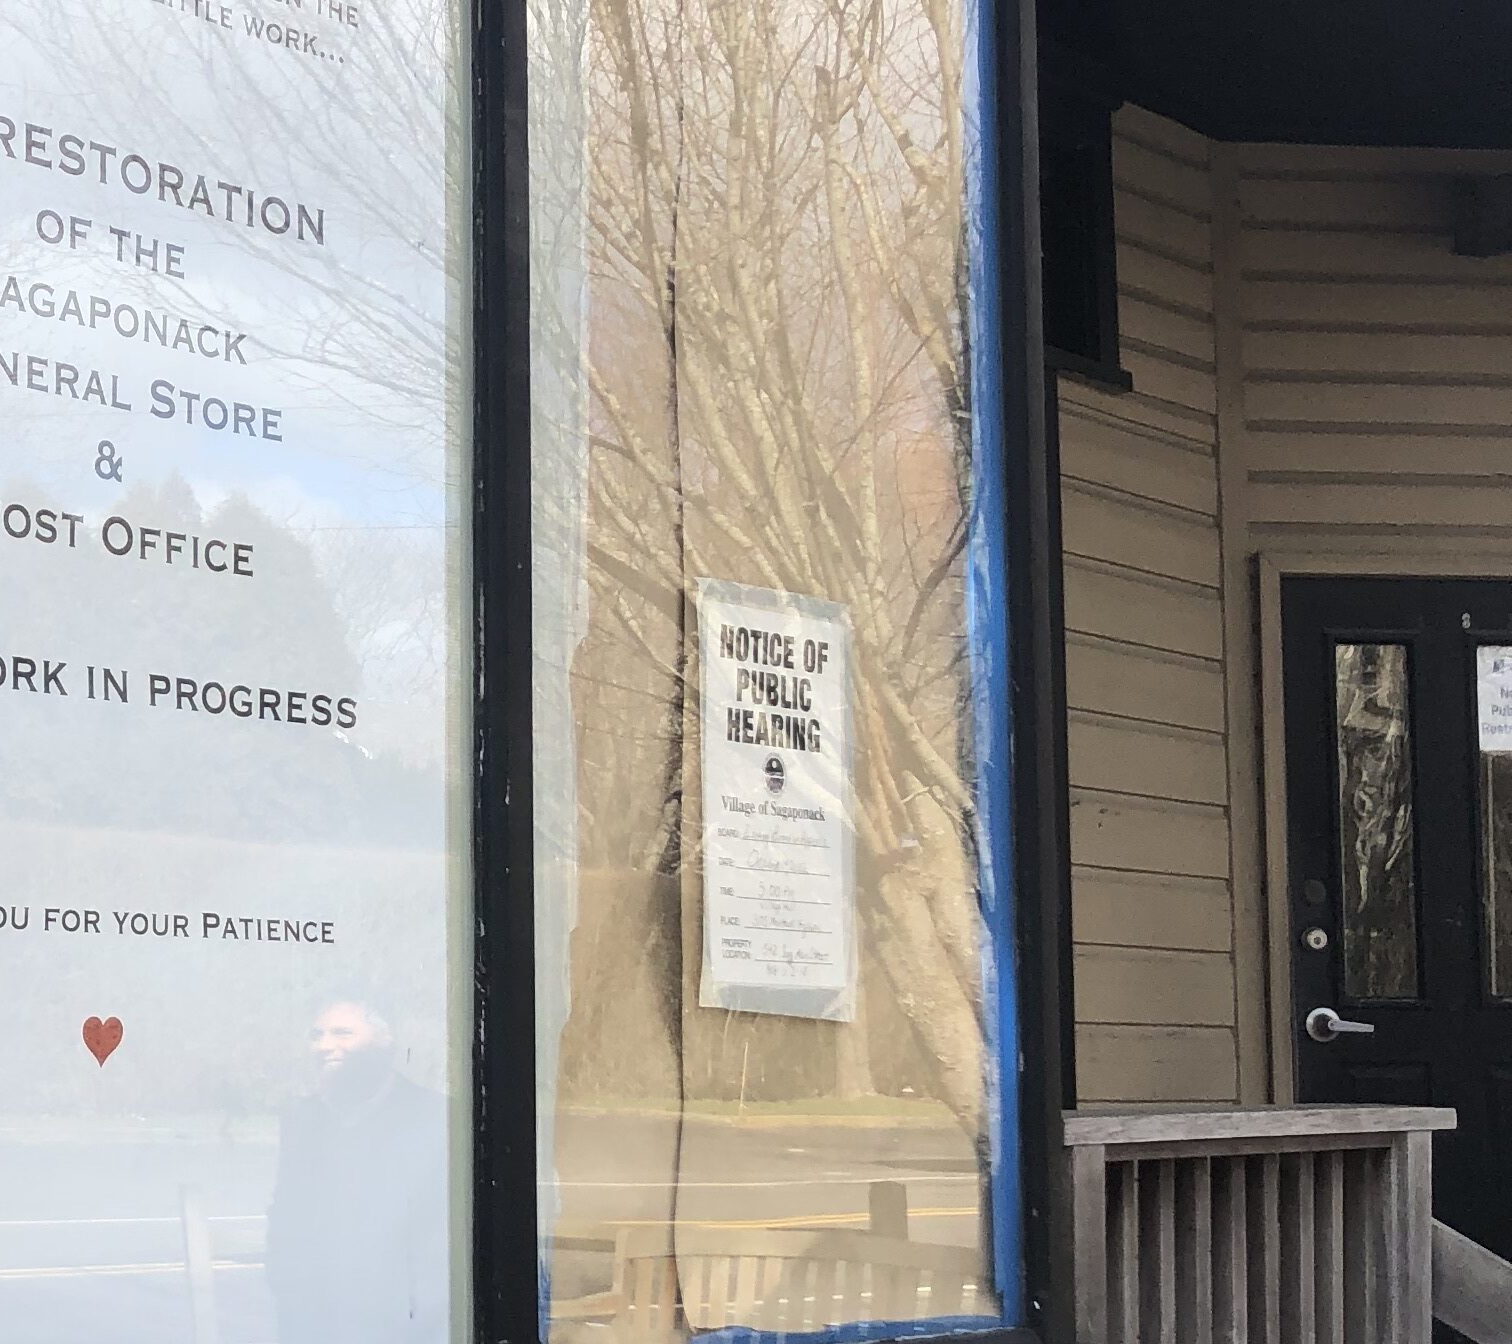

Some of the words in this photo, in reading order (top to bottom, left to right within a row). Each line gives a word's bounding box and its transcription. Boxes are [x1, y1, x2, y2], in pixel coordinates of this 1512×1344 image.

[244, 17, 346, 64] WORK...
[36, 209, 92, 250] OF
[109, 225, 186, 280] THE
[149, 379, 283, 442] STORE
[94, 439, 123, 483] &
[102, 516, 254, 578] OFFICE
[720, 623, 795, 669] NOTICE
[803, 638, 829, 675] OF
[86, 665, 129, 704] IN
[148, 673, 358, 730] PROGRESS
[736, 668, 812, 712] PUBLIC
[726, 707, 821, 753] HEARING
[721, 795, 756, 817] Village
[758, 801, 770, 816] of
[43, 907, 101, 935] FOR
[112, 910, 190, 939] YOUR
[201, 912, 336, 945] PATIENCE
